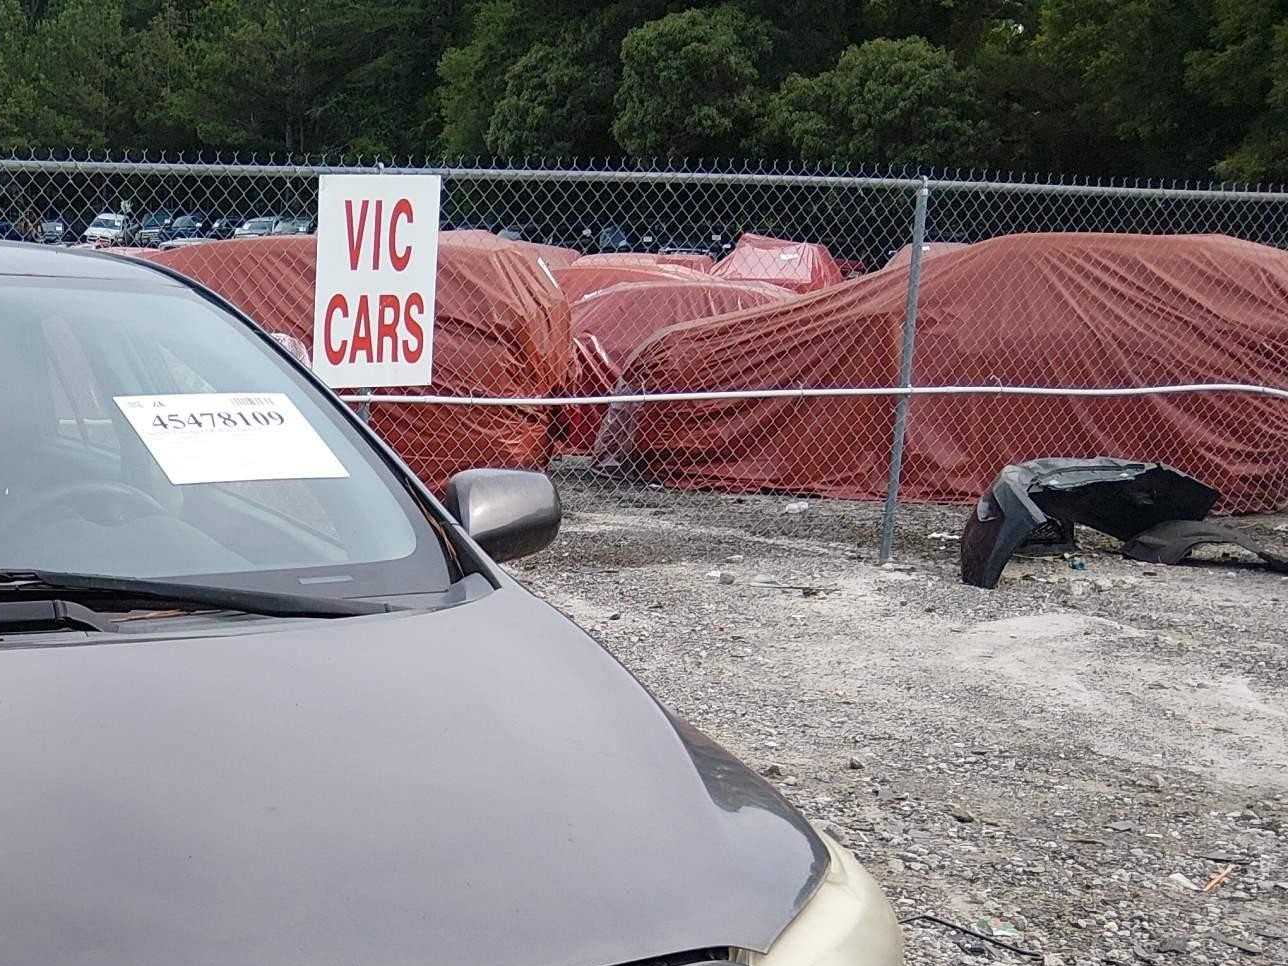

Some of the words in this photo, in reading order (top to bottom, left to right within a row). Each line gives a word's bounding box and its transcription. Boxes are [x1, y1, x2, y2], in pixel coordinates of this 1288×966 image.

[344, 198, 414, 272] VIC
[324, 292, 425, 366] CARS
[152, 411, 285, 429] 45478109
